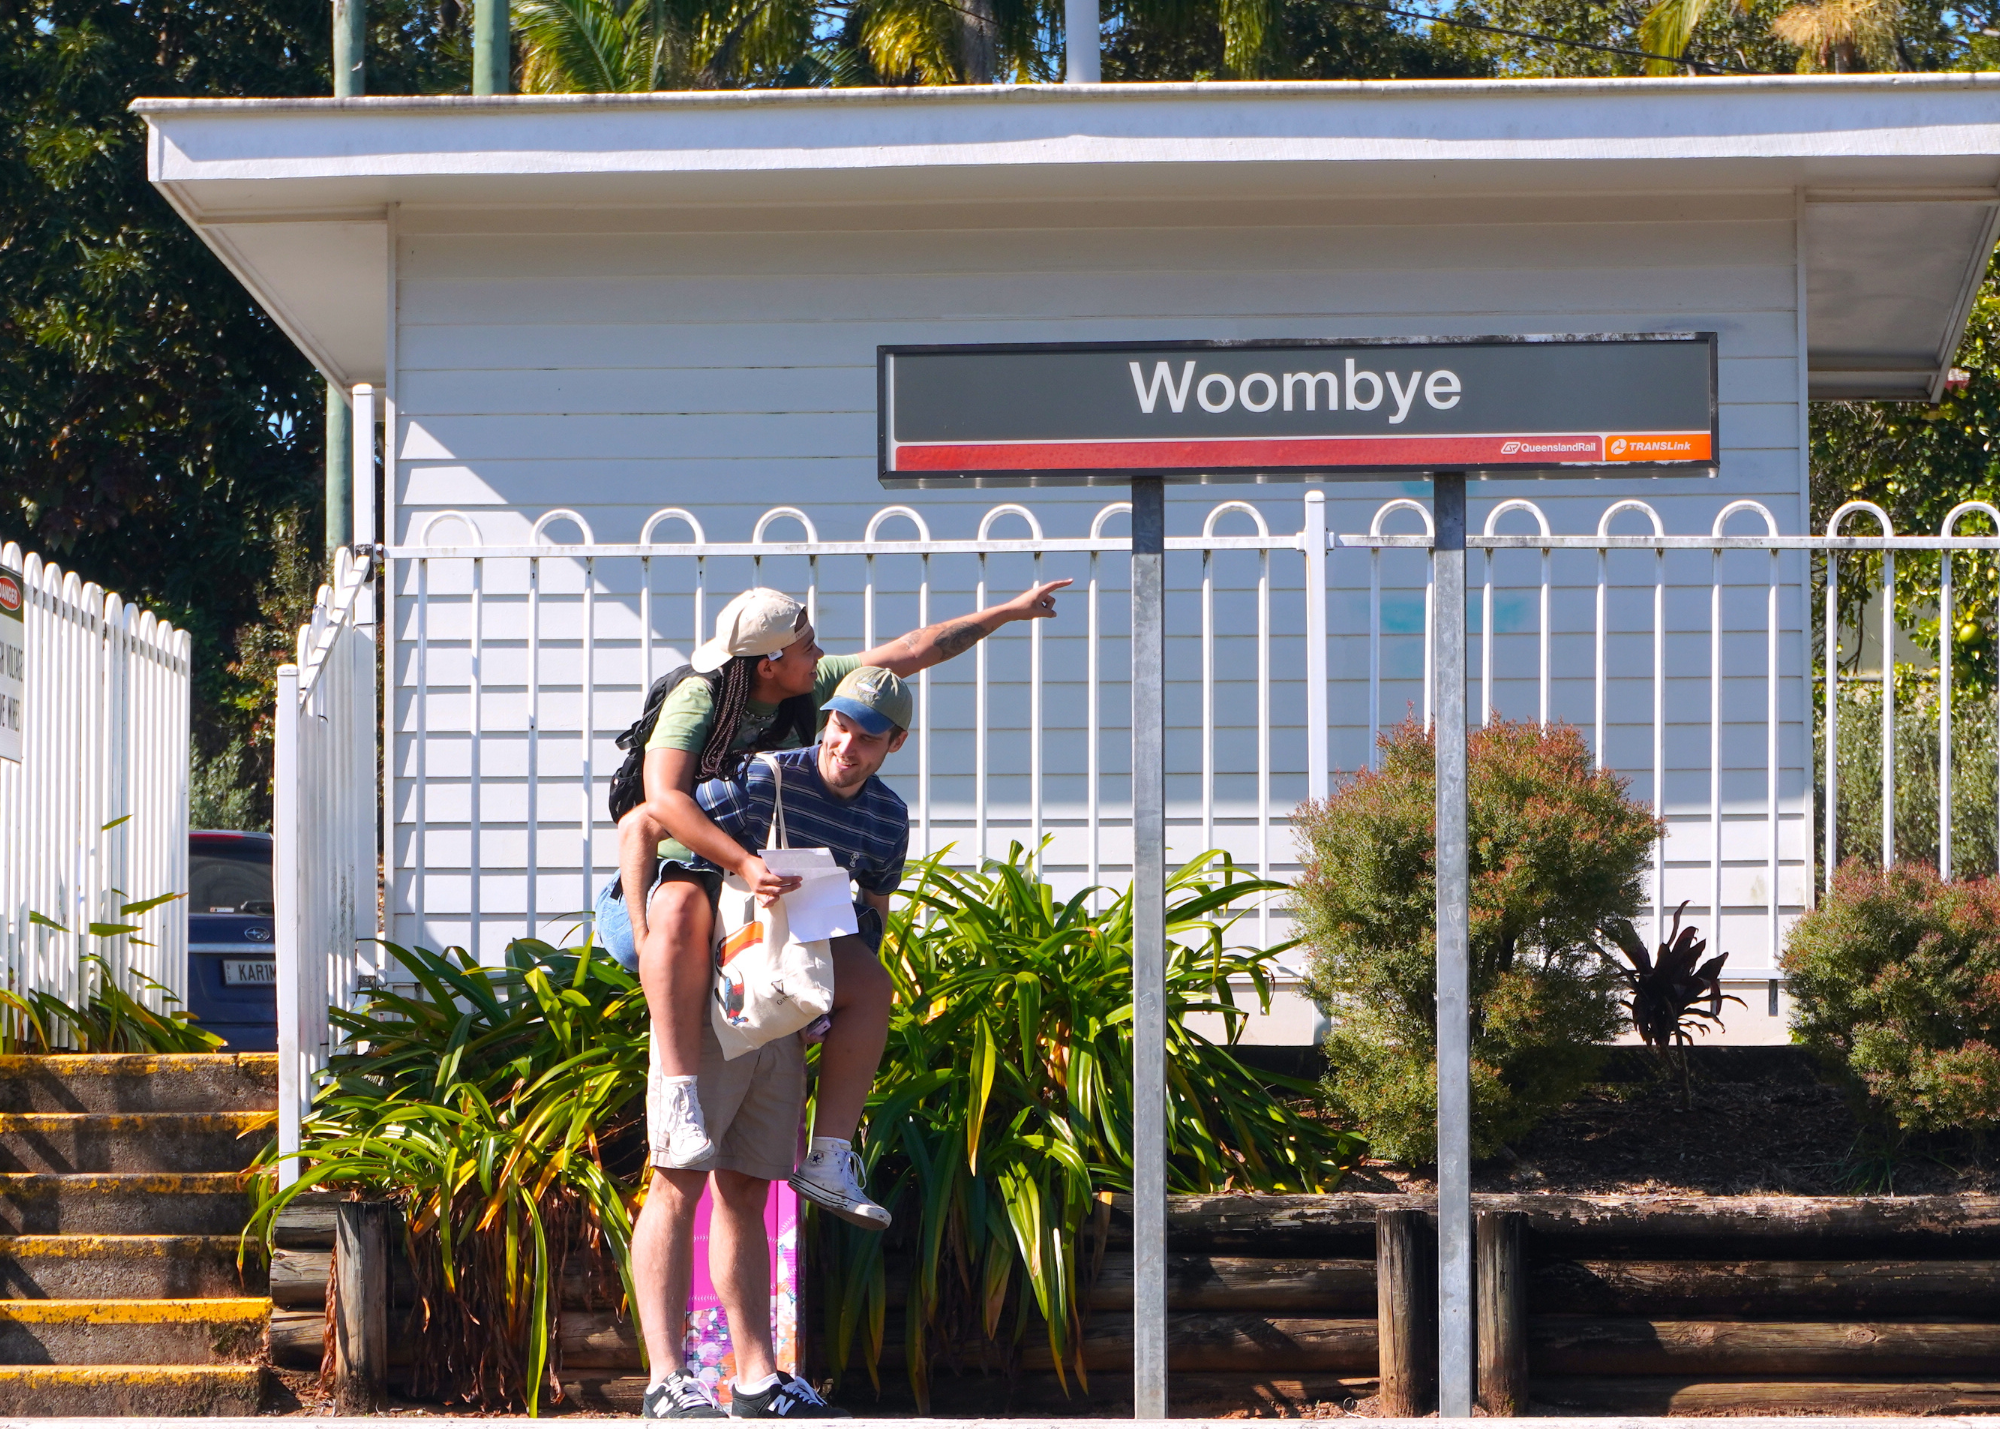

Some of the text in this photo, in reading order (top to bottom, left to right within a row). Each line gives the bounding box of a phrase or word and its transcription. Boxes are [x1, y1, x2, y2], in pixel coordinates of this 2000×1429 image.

[1129, 358, 1462, 424] Woombye
[1520, 442, 1596, 453] QueenslandRail
[1629, 441, 1691, 451] TRANSLink
